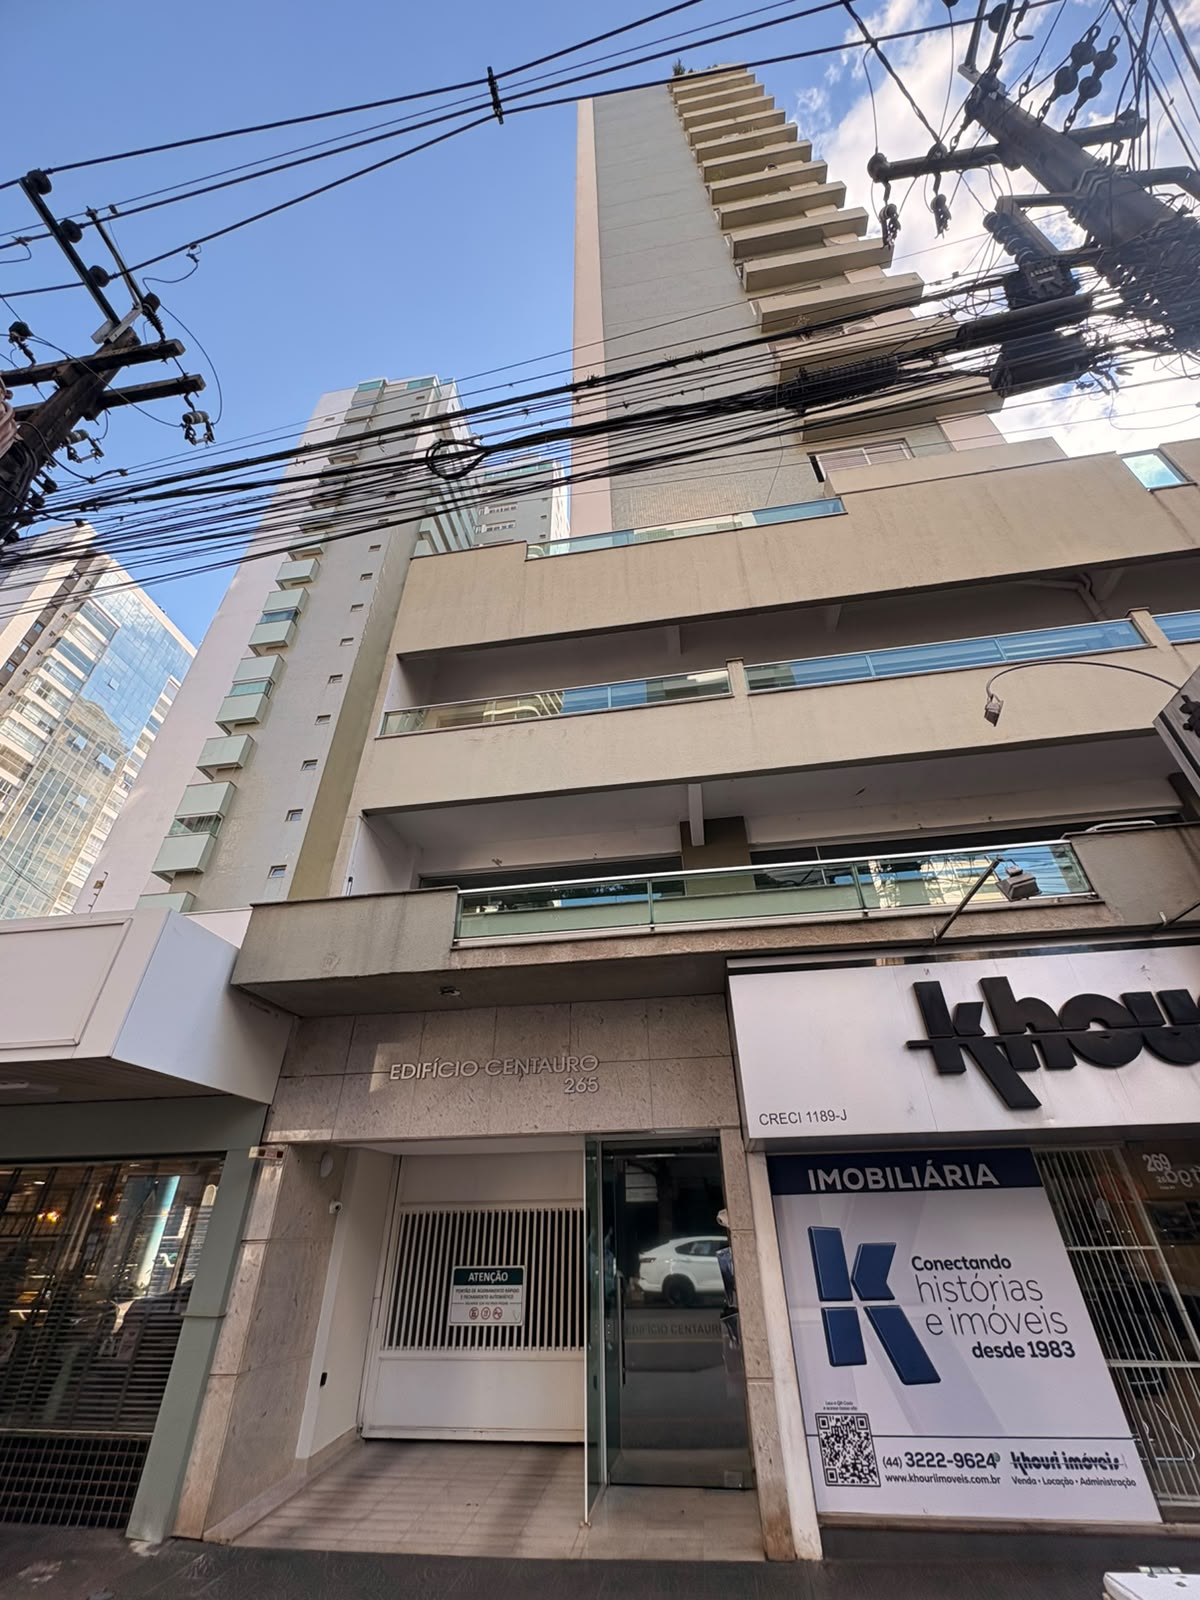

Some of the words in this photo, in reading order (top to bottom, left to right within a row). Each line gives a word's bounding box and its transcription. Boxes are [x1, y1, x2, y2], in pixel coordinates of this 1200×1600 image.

[390, 1058, 480, 1080] EDIFÍCIO
[484, 1055, 600, 1076] CENTAURO
[563, 1076, 600, 1094] 265
[759, 1111, 802, 1126] CRECI
[806, 1109, 847, 1123] 1189-J
[1142, 1152, 1172, 1172] 269
[807, 1159, 1000, 1192] IMOBILIÁRIA
[911, 1254, 1012, 1271] Conectando
[467, 1270, 509, 1284] ATENÇÃO
[915, 1272, 1043, 1303] histórias
[925, 1313, 943, 1336] e
[948, 1304, 1068, 1335] imóveis
[971, 1341, 1026, 1359] desde
[1027, 1340, 1076, 1358] 1983
[882, 1455, 903, 1469] (44)
[904, 1451, 998, 1469] 3222-9624
[1010, 1451, 1061, 1476] khouri
[1011, 1476, 1037, 1485] Venda
